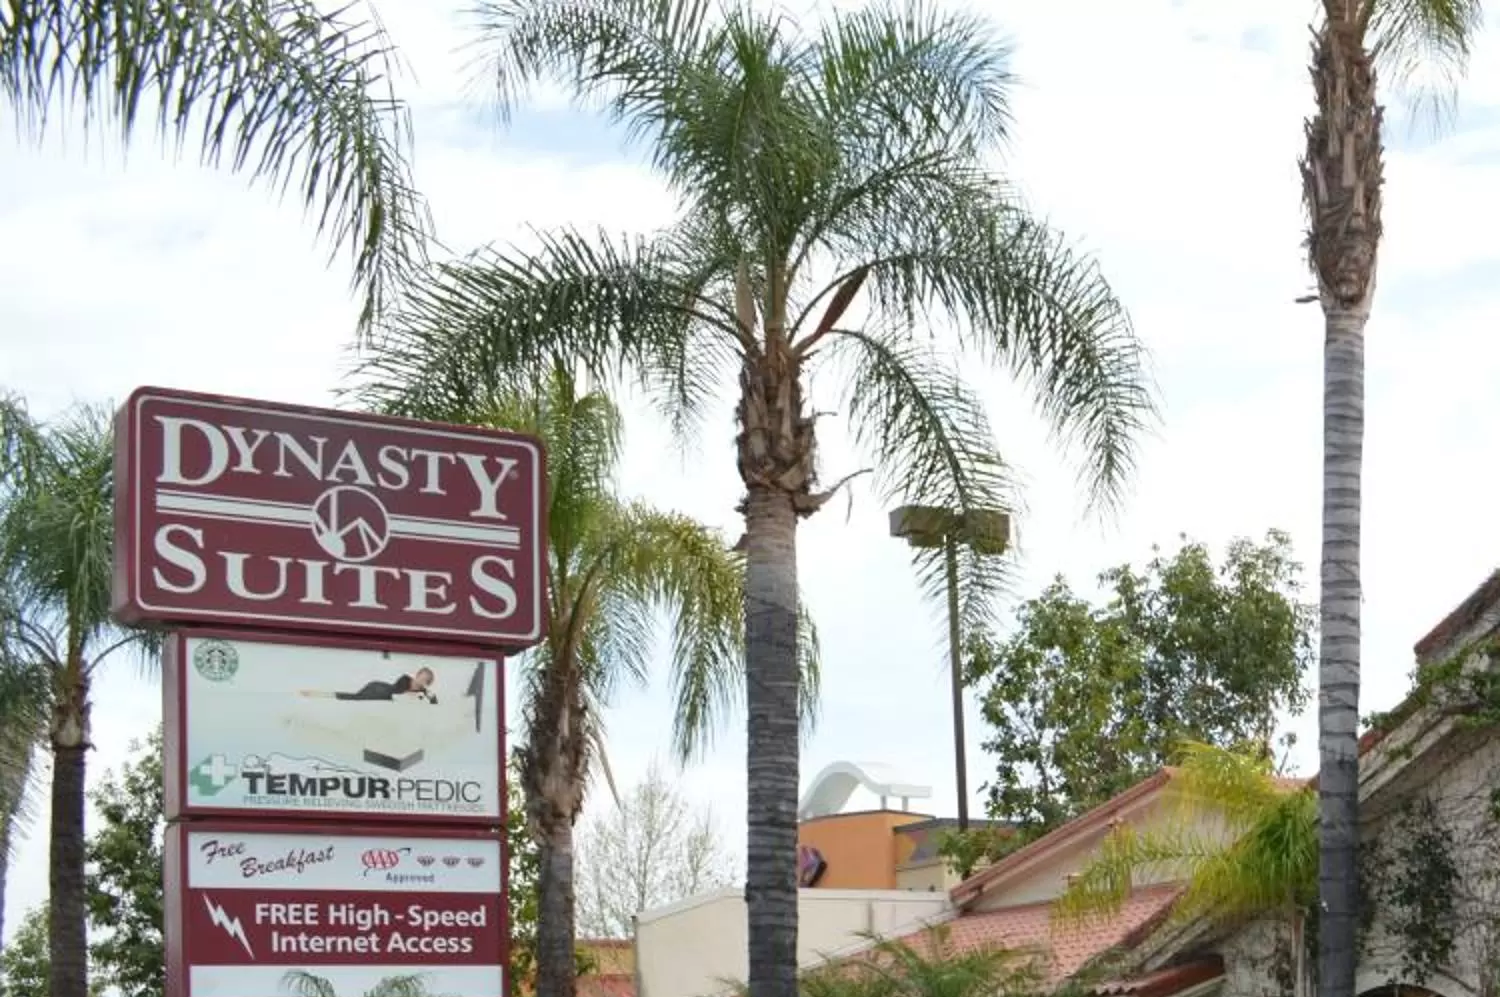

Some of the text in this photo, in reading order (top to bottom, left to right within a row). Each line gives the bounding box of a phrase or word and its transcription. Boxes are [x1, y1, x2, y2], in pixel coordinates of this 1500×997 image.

[153, 415, 518, 519] DYNASTY
[152, 523, 518, 619] SUITES
[200, 840, 246, 865] Free
[239, 845, 335, 878] Breakfast
[255, 903, 319, 926] FREE
[271, 930, 473, 954] Internet Access
